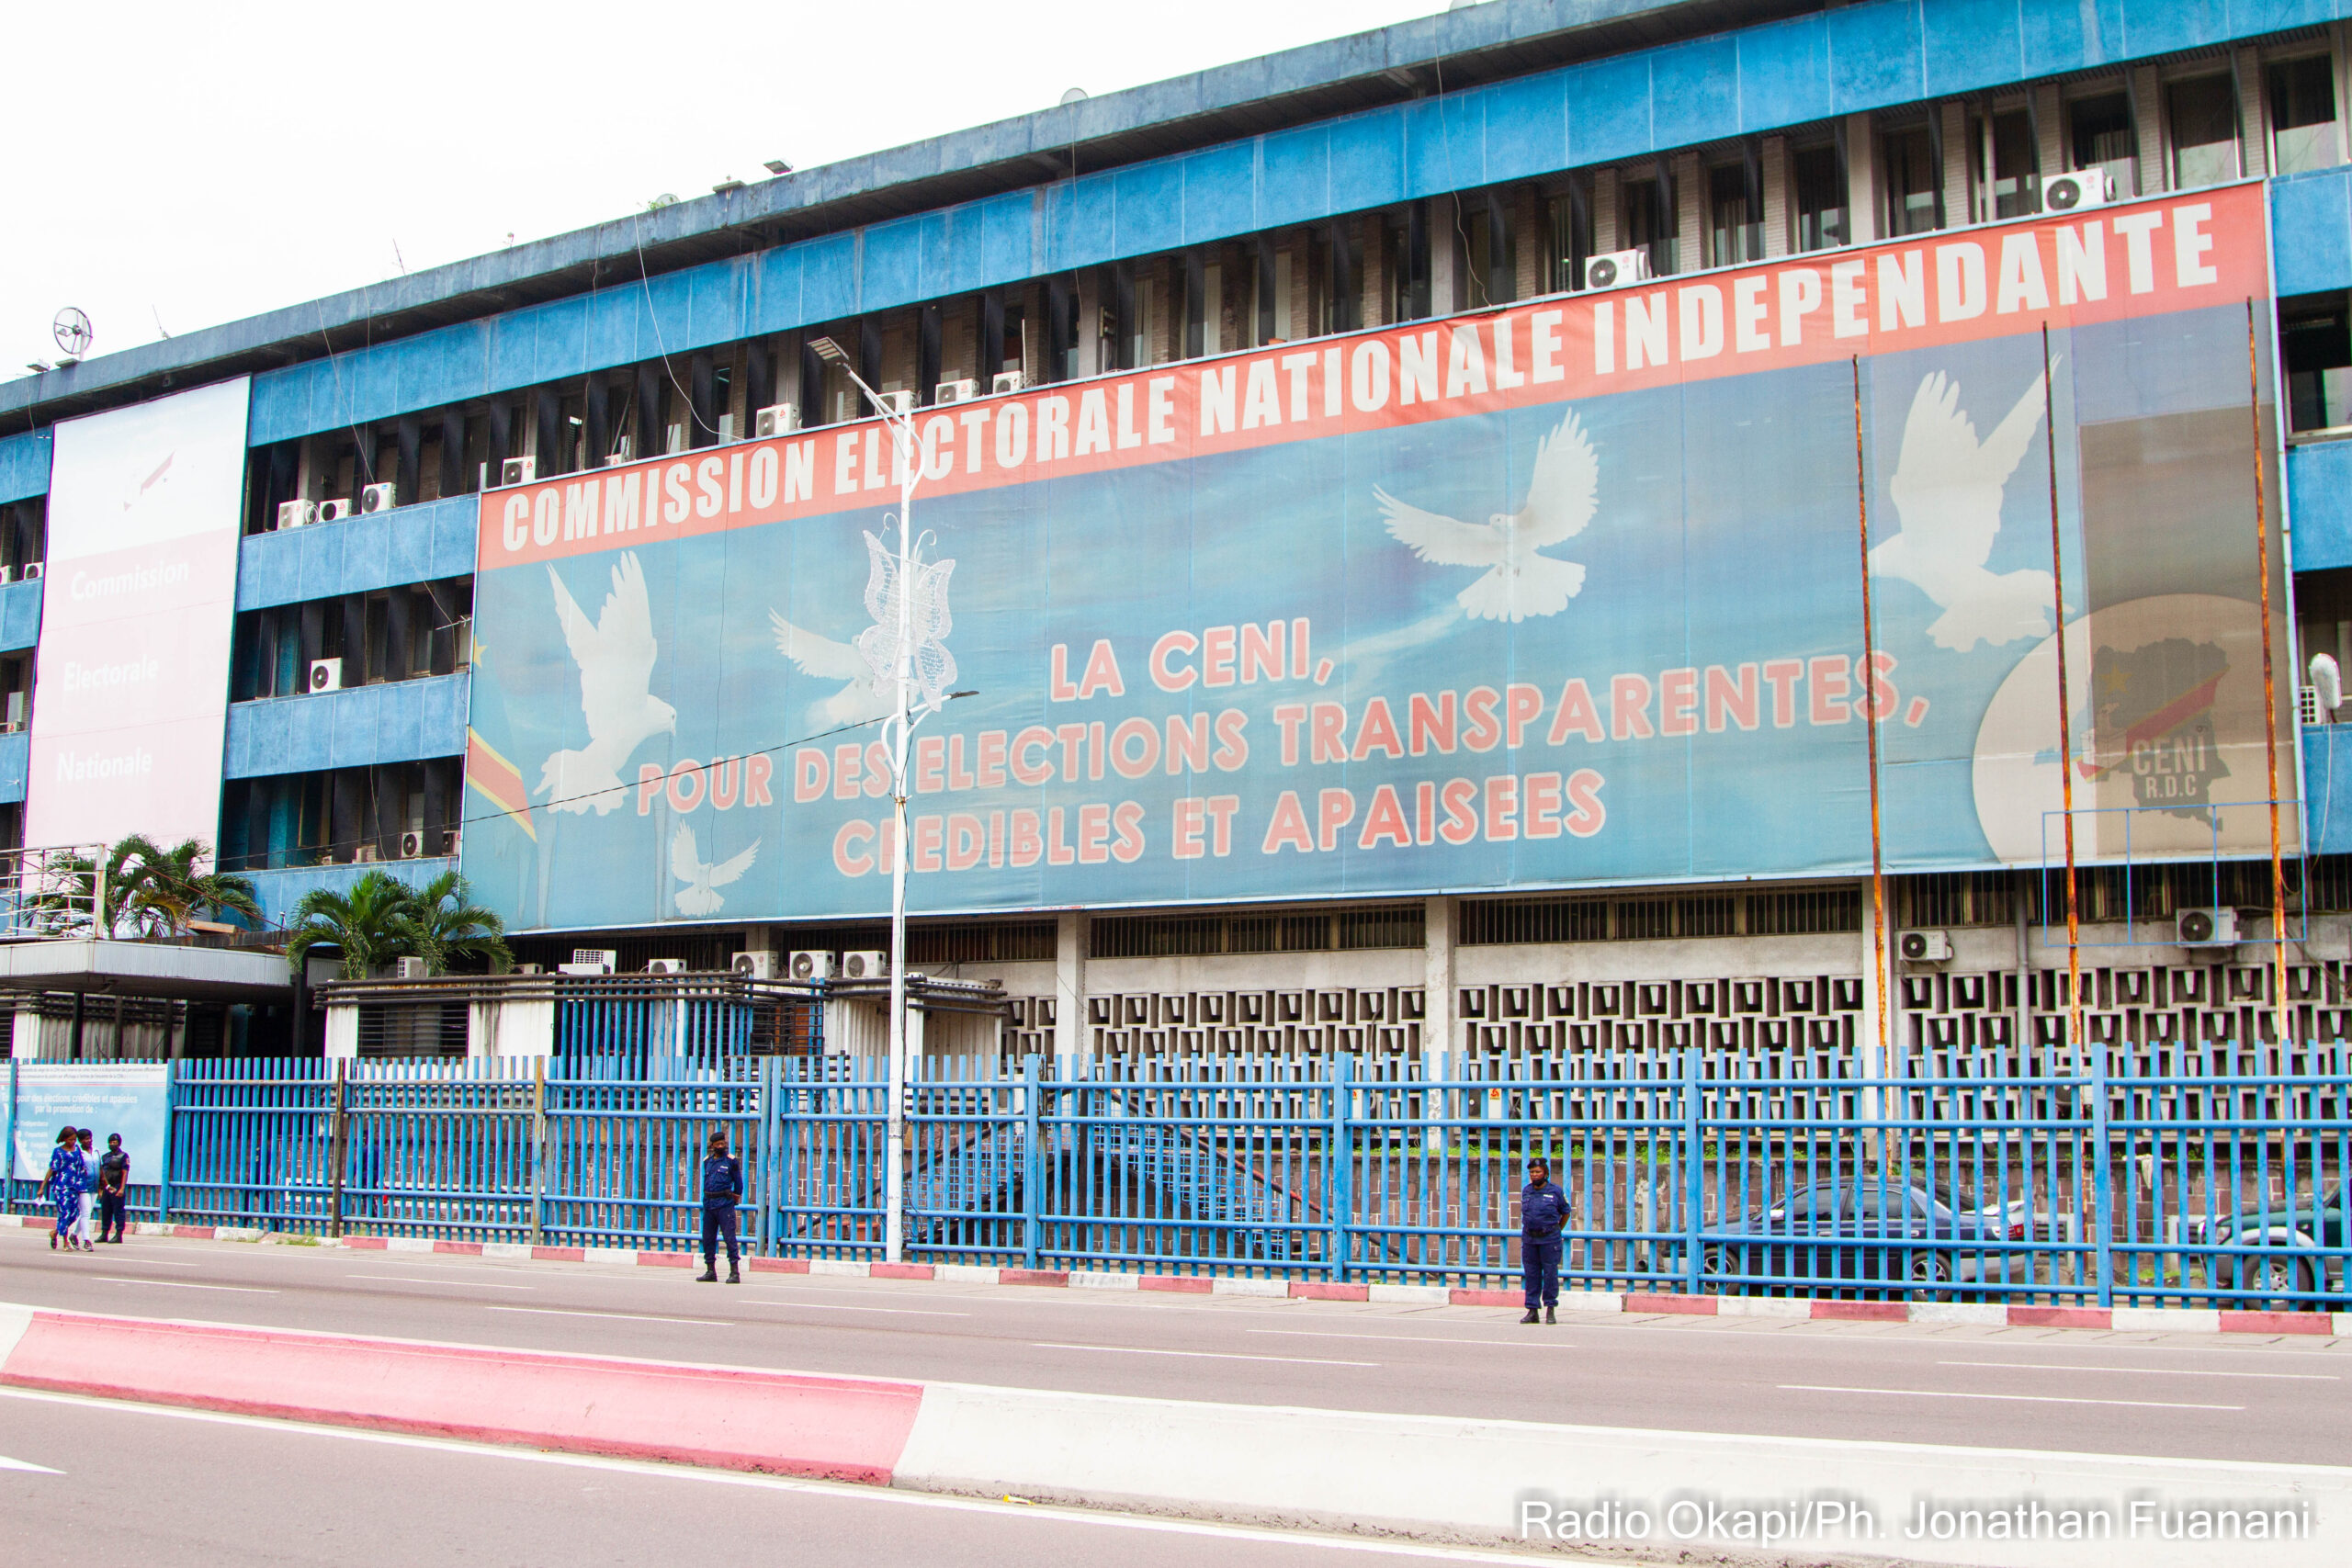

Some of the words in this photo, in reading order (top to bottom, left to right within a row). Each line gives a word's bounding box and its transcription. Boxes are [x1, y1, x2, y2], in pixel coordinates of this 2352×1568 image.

[503, 439, 816, 551] COMMISSION
[834, 376, 1176, 496] ELECTORALE
[1200, 310, 1566, 437] NATIONALE
[1594, 203, 2218, 376] INDEPENDANTE
[71, 559, 190, 601] Commission
[63, 654, 160, 692] Electorale
[1050, 638, 1125, 702] LA
[1149, 617, 1334, 692] CENI,
[638, 751, 774, 817] POUR
[794, 740, 893, 804] DES
[914, 707, 1249, 794] ELECTIONS
[1272, 649, 1930, 766] TRANSPARENTES,
[57, 747, 153, 783] Nationale
[2132, 736, 2205, 776] CENI
[2145, 774, 2197, 799] R.D.C
[1171, 795, 1240, 861] ET
[1261, 768, 1606, 855] APAISEES
